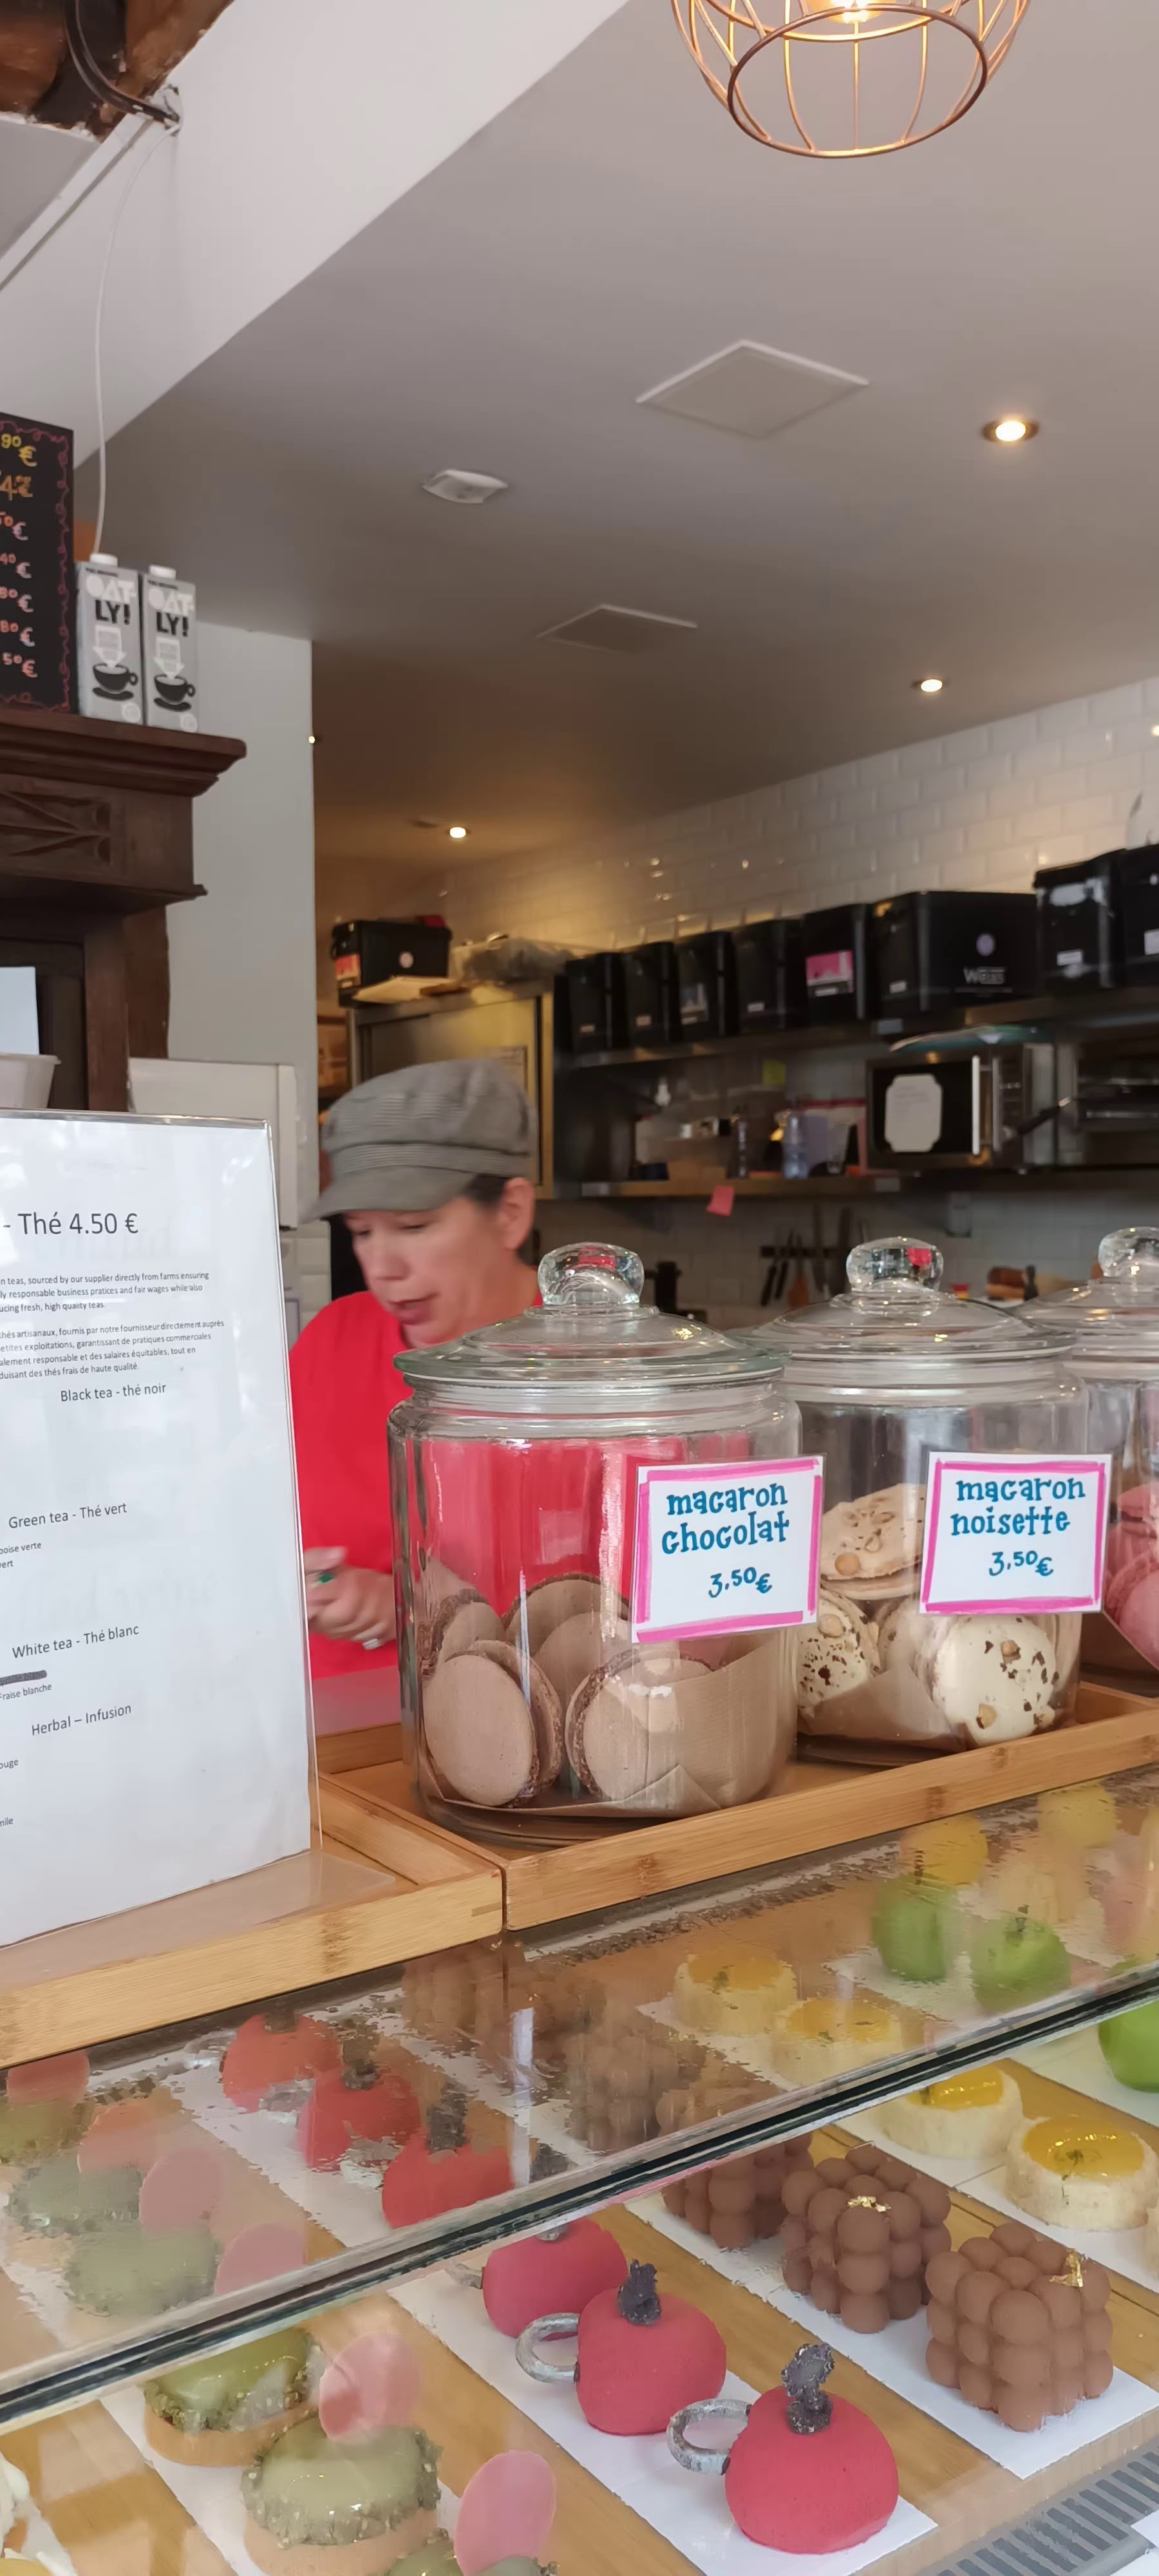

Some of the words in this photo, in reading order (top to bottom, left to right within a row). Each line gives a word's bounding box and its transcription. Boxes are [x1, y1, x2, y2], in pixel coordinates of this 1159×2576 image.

[95, 600, 131, 625] LY!
[156, 612, 189, 638] LY!
[17, 1211, 62, 1235] Thé
[69, 1213, 117, 1235] 4.50
[124, 1213, 138, 1234] €
[7, 1278, 26, 1286] teas,
[28, 1275, 58, 1285] sourced
[59, 1275, 69, 1285] by
[84, 1274, 113, 1283] supplier
[114, 1273, 140, 1283] directly
[142, 1273, 159, 1281] from
[160, 1272, 180, 1280] farms
[180, 1272, 209, 1280] ensuring
[9, 1288, 55, 1299] responsable
[57, 1287, 89, 1296] business
[90, 1287, 118, 1296] pratices
[119, 1285, 133, 1294] and
[147, 1286, 169, 1294] wages
[170, 1283, 188, 1292] while
[21, 1303, 43, 1312] fresh,
[44, 1302, 61, 1312] high
[62, 1302, 87, 1312] quality
[16, 1330, 58, 1338] artisanaux,
[59, 1327, 85, 1336] fournis
[86, 1327, 99, 1336] par
[120, 1324, 160, 1332] fournisseur
[160, 1321, 202, 1330] directement
[202, 1320, 225, 1329] auprès
[0, 1344, 23, 1352] etites
[24, 1340, 75, 1352] exploitations,
[77, 1338, 120, 1350] garantissant
[121, 1336, 131, 1345] de
[132, 1336, 165, 1346] pratiques
[166, 1332, 212, 1342] commerciales
[33, 1353, 79, 1365] responsable
[89, 1352, 102, 1360] des
[104, 1350, 130, 1359] salaires
[131, 1347, 170, 1359] équitables,
[171, 1347, 185, 1355] tout
[28, 1369, 43, 1378] des
[44, 1367, 61, 1377] thés
[62, 1367, 79, 1375] frais
[80, 1365, 90, 1374] de
[90, 1365, 112, 1373] haute
[113, 1361, 140, 1373] qualité.
[61, 1388, 92, 1402] Black
[94, 1388, 113, 1399] tea
[122, 1383, 141, 1397] thé
[144, 1382, 167, 1395] noir
[666, 1482, 789, 1515] macaron
[954, 1477, 1086, 1502] macaron
[8, 1515, 46, 1529] Green
[49, 1512, 68, 1523] tea
[79, 1504, 102, 1519] Thé
[104, 1502, 127, 1515] vert
[950, 1506, 1071, 1536] noisette
[661, 1510, 789, 1555] chocolat
[21, 1542, 42, 1551] verte
[988, 1550, 1054, 1577] 3,50€
[12, 1643, 50, 1659] White
[53, 1639, 72, 1651] tea
[83, 1629, 106, 1645] Thé
[108, 1625, 139, 1640] blanc
[23, 1684, 52, 1696] blanche
[32, 1715, 71, 1736] Herbal
[86, 1705, 131, 1724] Infusion
